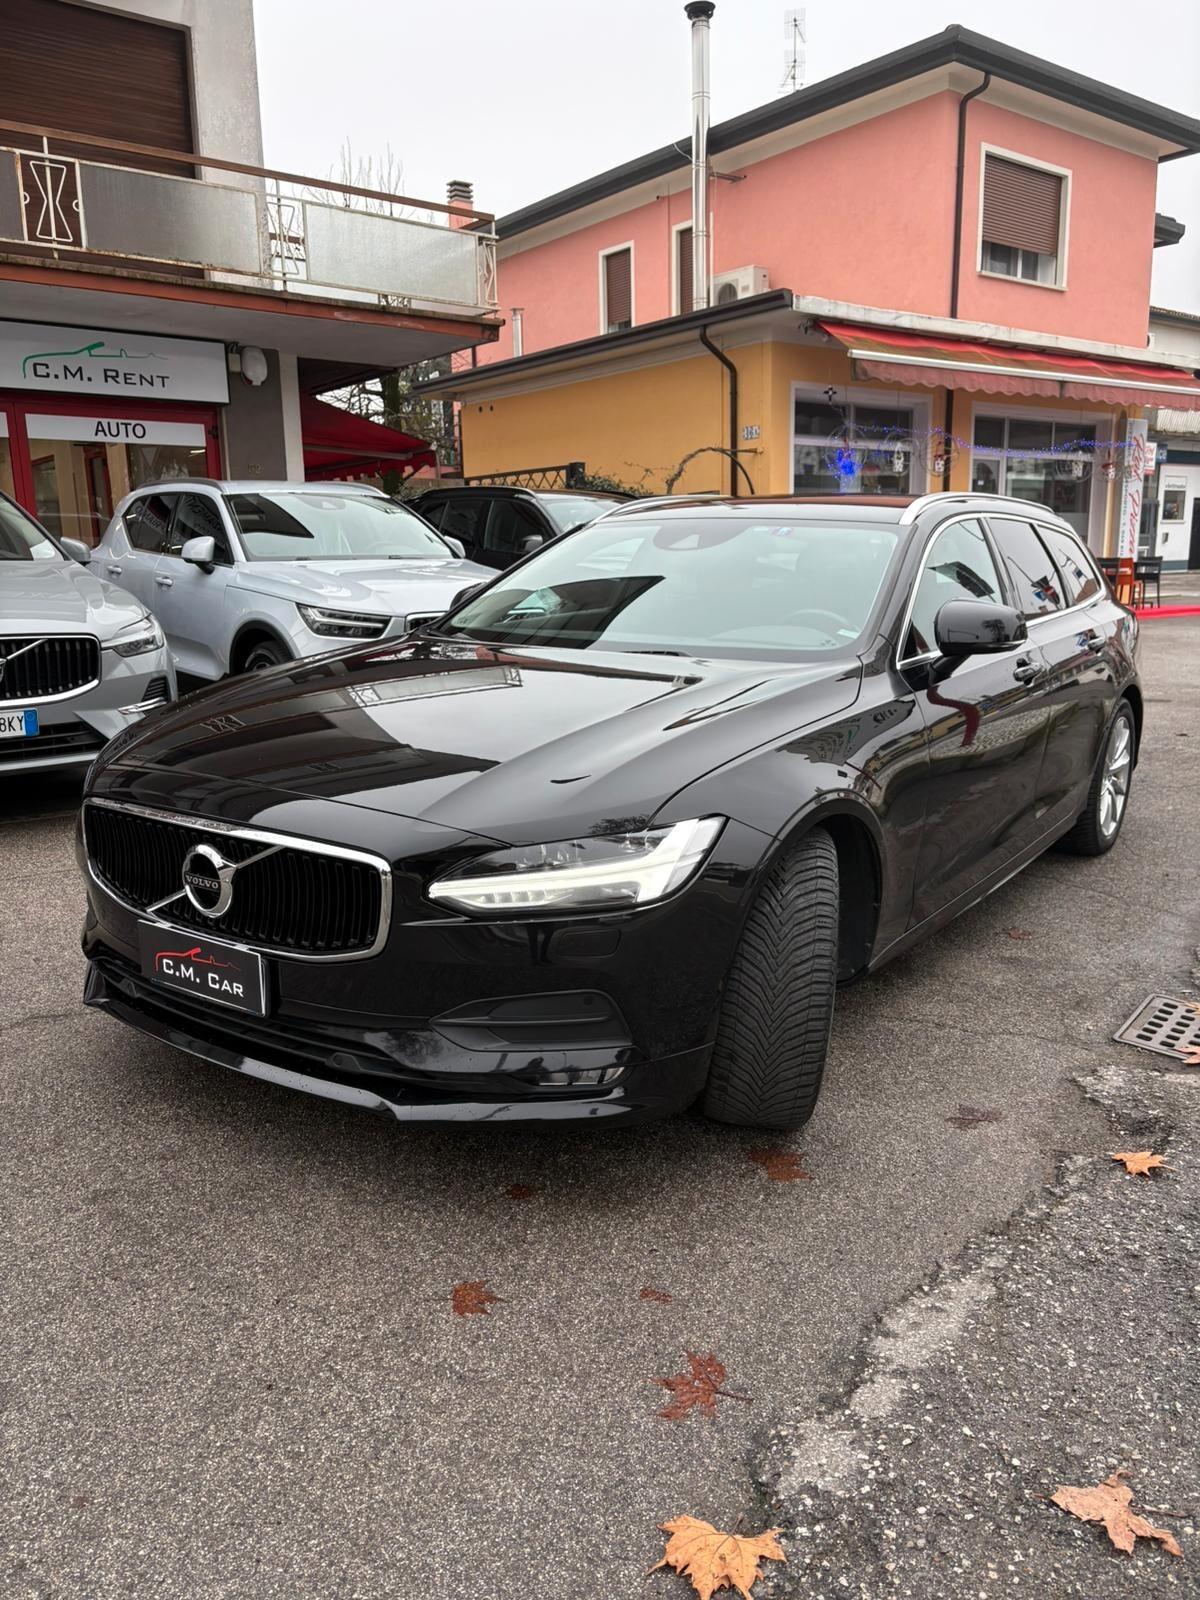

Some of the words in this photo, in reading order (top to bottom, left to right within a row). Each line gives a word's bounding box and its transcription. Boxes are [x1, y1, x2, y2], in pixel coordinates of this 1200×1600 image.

[32, 362, 93, 383] C.M.
[94, 420, 147, 439] AUTO
[186, 875, 219, 889] VOLVO
[162, 958, 200, 983] C.M.
